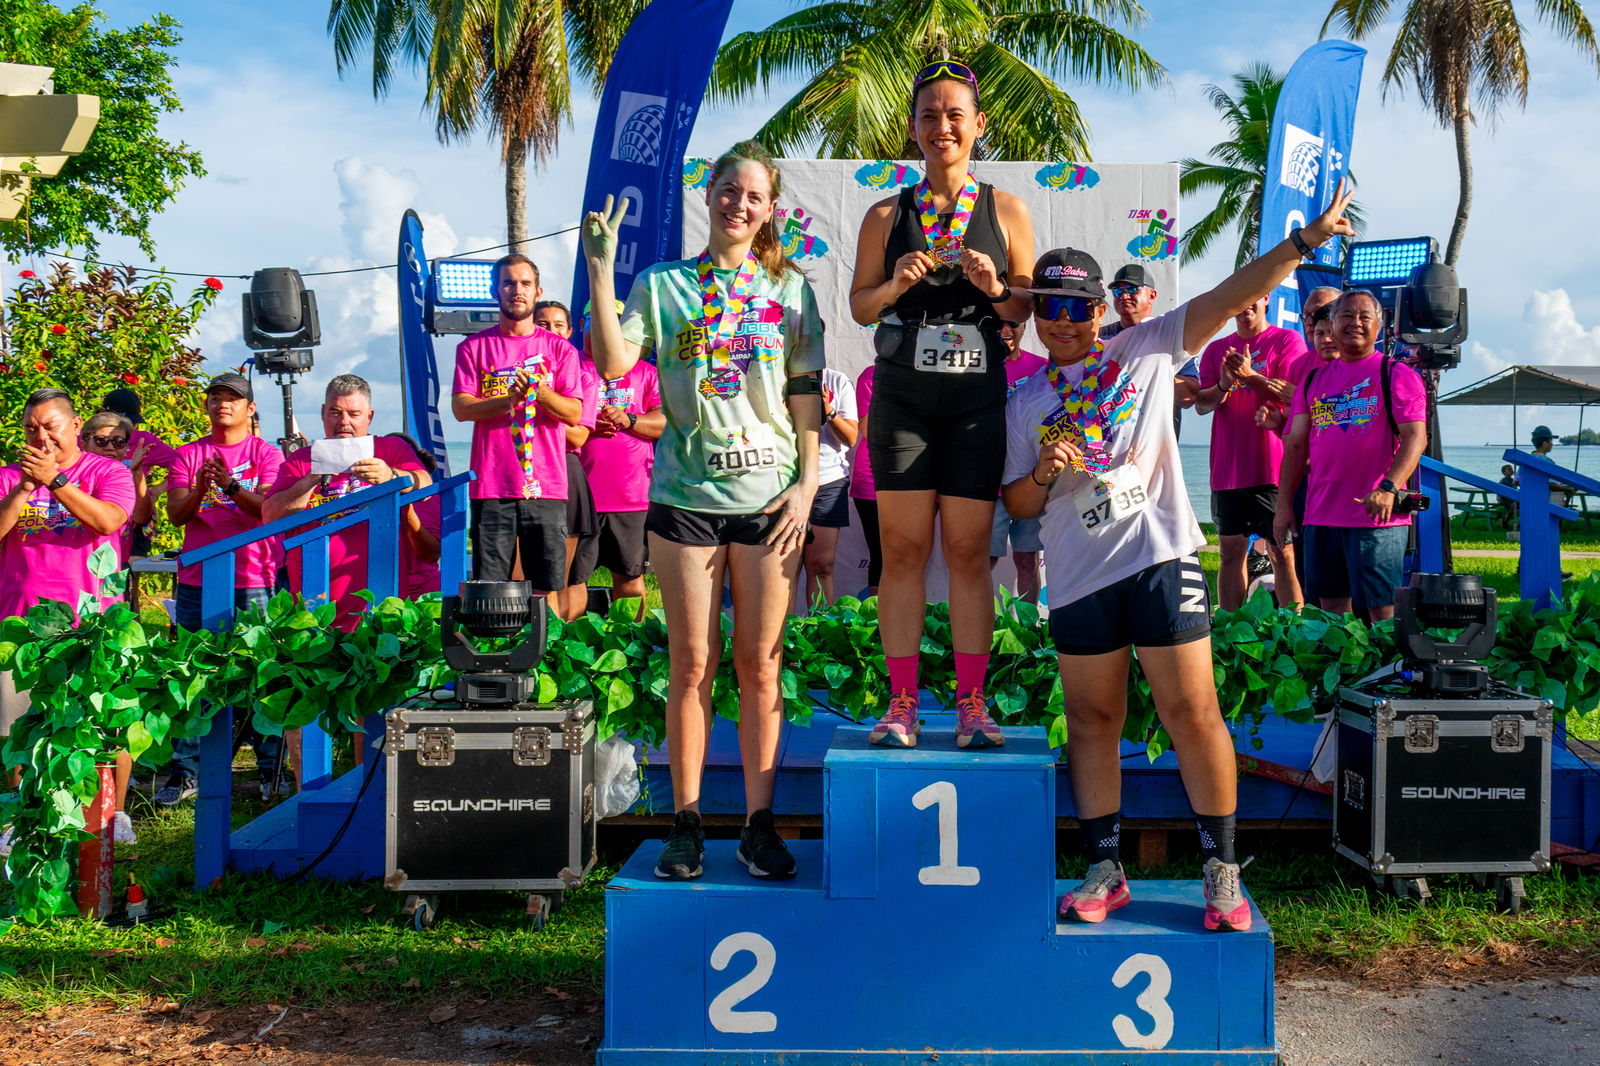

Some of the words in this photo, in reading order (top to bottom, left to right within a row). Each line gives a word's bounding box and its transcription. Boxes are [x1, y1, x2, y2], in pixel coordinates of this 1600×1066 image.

[1044, 265, 1062, 277] 670
[1061, 265, 1088, 277] Babes
[735, 322, 785, 336] UBBLE
[922, 348, 982, 368] 3415
[483, 387, 507, 399] COL
[1099, 382, 1137, 419] RUN
[708, 447, 775, 471] 4005
[1082, 485, 1146, 529] 3795
[1401, 786, 1526, 800] SOUNDHIRE
[413, 798, 551, 812] SOUNDHIRE
[911, 781, 981, 886] 1
[709, 931, 777, 1034] 2
[1111, 953, 1174, 1050] 3
